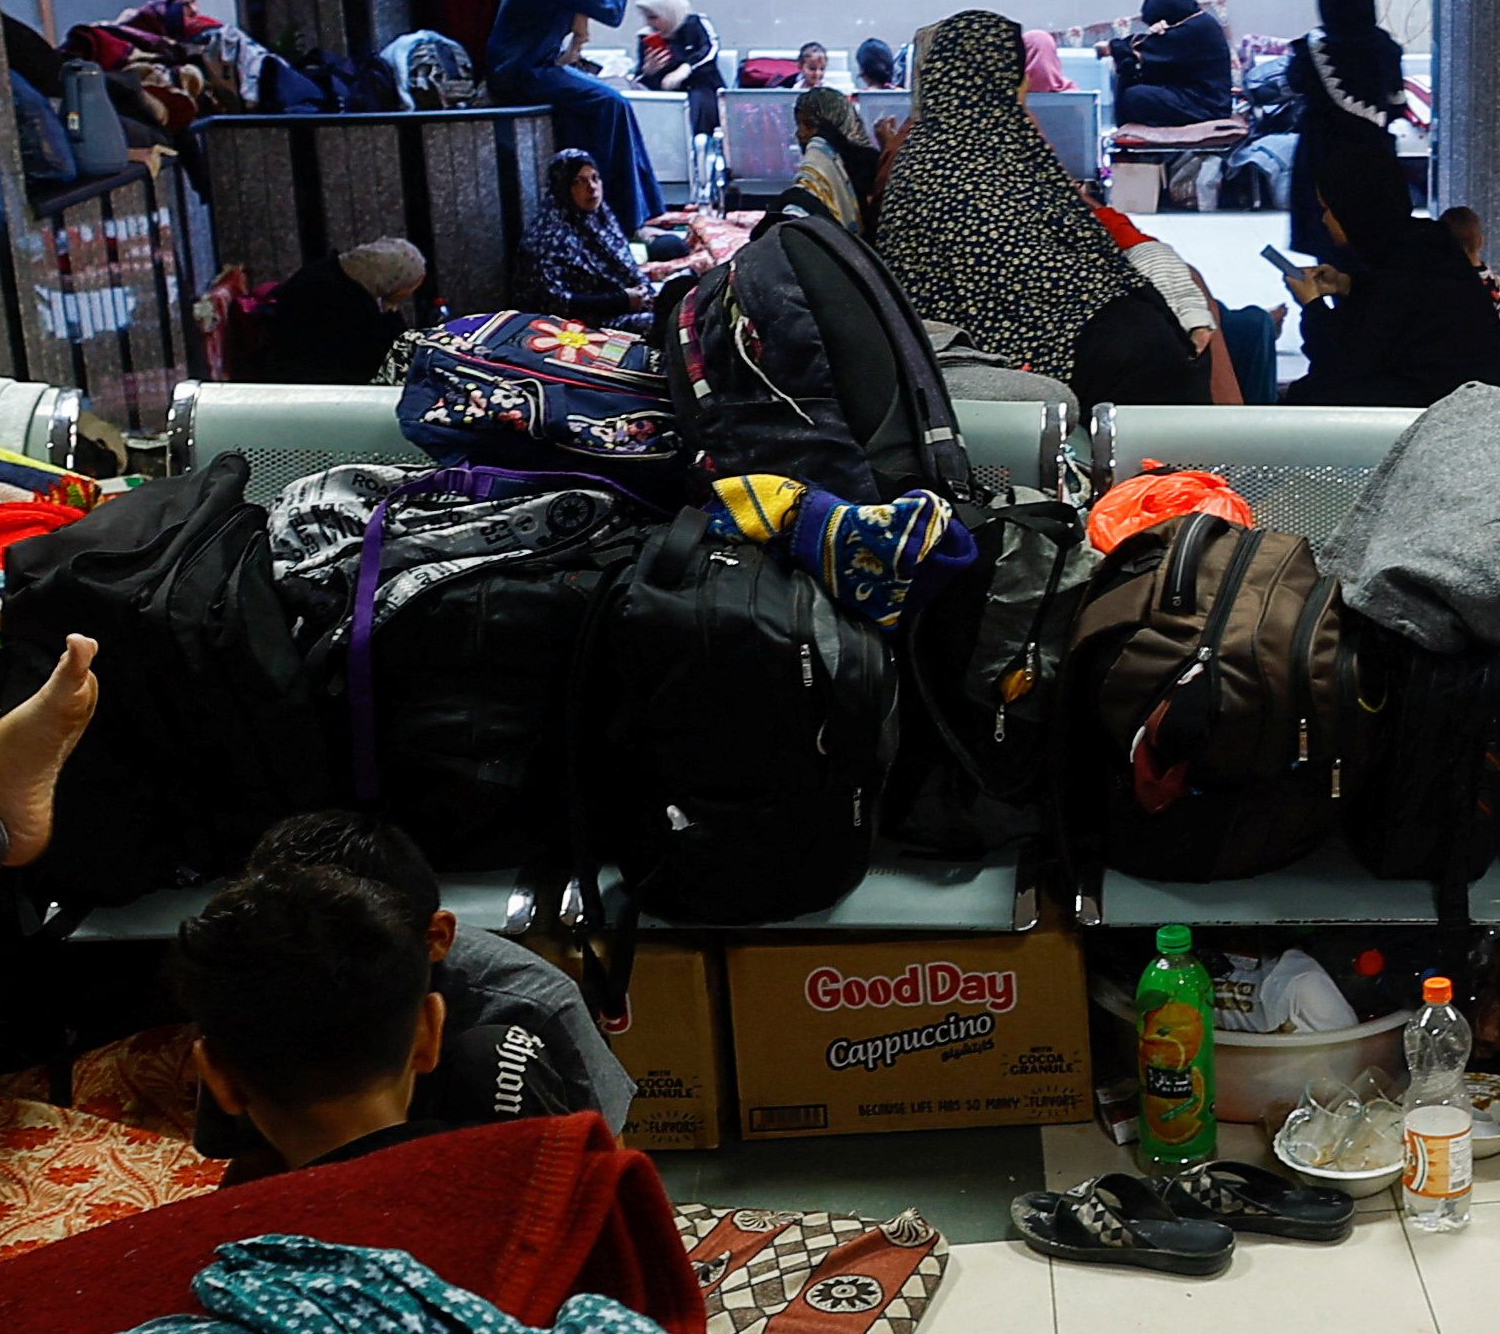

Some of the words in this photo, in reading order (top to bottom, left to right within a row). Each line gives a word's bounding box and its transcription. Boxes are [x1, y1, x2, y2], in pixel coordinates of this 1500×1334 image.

[805, 964, 922, 1010] Good
[925, 961, 1017, 1012] Day
[827, 1014, 993, 1068] Cappuccino
[1018, 1054, 1065, 1064] COCOA
[1010, 1063, 1074, 1075] GRANULE
[636, 1078, 684, 1089] COCOA
[858, 1103, 906, 1117] BECAUSE
[911, 1101, 933, 1114] LIFE
[966, 1099, 981, 1111] SO
[1029, 1094, 1076, 1108] FLAVORS
